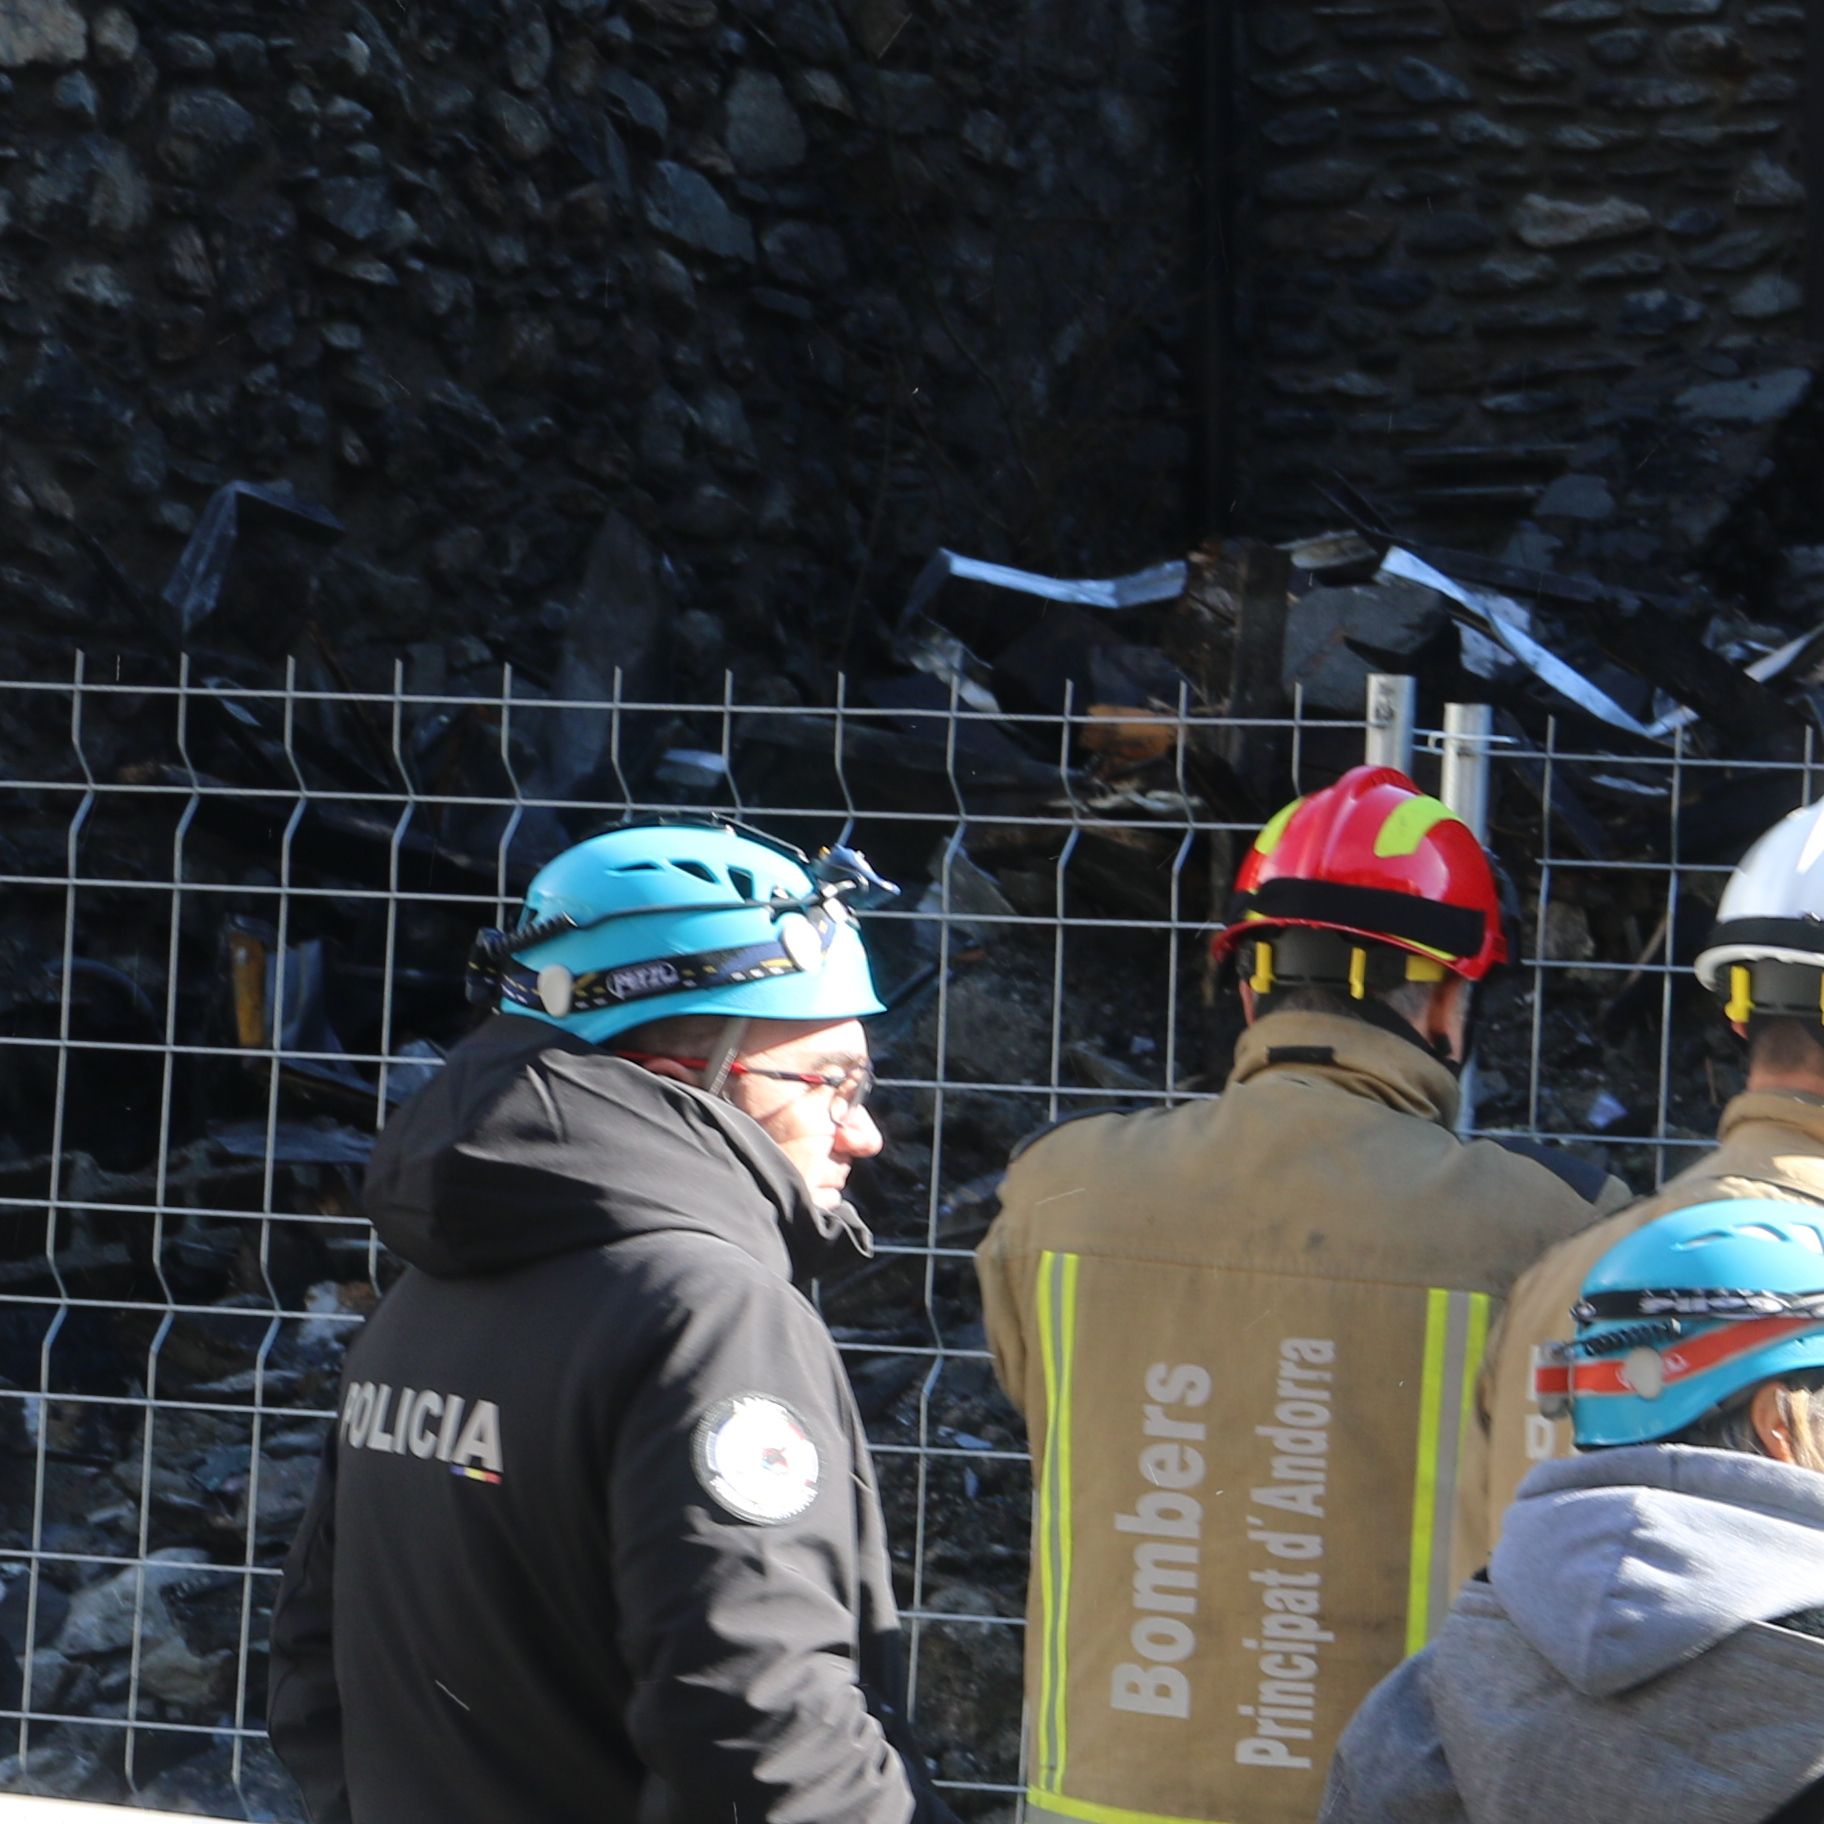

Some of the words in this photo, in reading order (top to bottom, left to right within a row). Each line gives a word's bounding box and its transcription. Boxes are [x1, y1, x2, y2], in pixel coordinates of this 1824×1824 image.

[341, 1381, 504, 1473] POLICIA
[1110, 1362, 1212, 1719] Bombers
[1234, 1571, 1336, 1769] Principat
